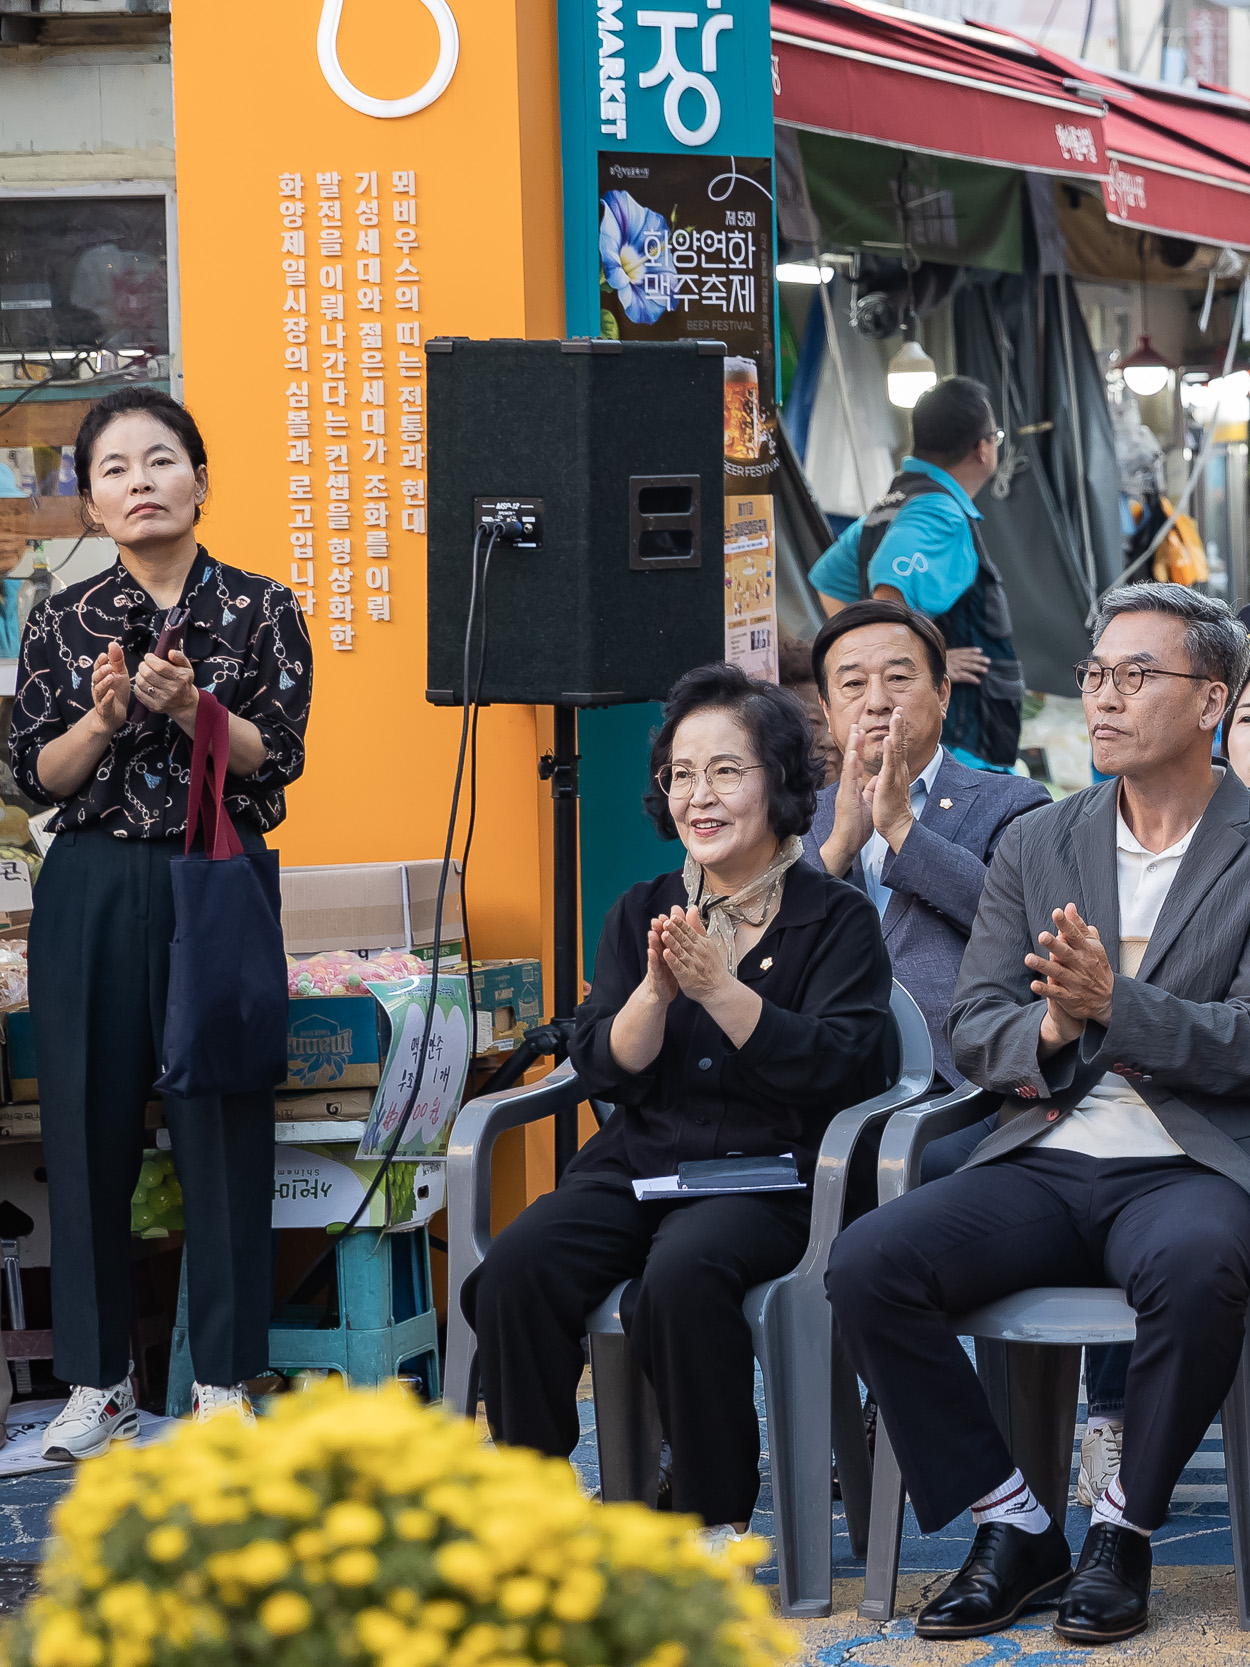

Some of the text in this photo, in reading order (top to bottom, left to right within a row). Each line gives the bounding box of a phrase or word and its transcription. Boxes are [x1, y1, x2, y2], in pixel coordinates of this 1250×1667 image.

[597, 0, 627, 140] MARKET
[644, 229, 756, 269] 화양연화
[644, 274, 755, 313] 맥주축제
[278, 172, 317, 616] 화양제일시장의 심볼과 로고입니다
[355, 170, 391, 621] 기성세대와 젊은세대가 조화를 이뤄
[392, 170, 426, 534] 뫼비우스의 띠는 전통과 현대
[686, 320, 754, 331] BEER FESTIVAL
[316, 171, 355, 651] 발전을 이뤄나간다는 컨셉을 형상화한
[411, 1033, 444, 1064] 맥안주
